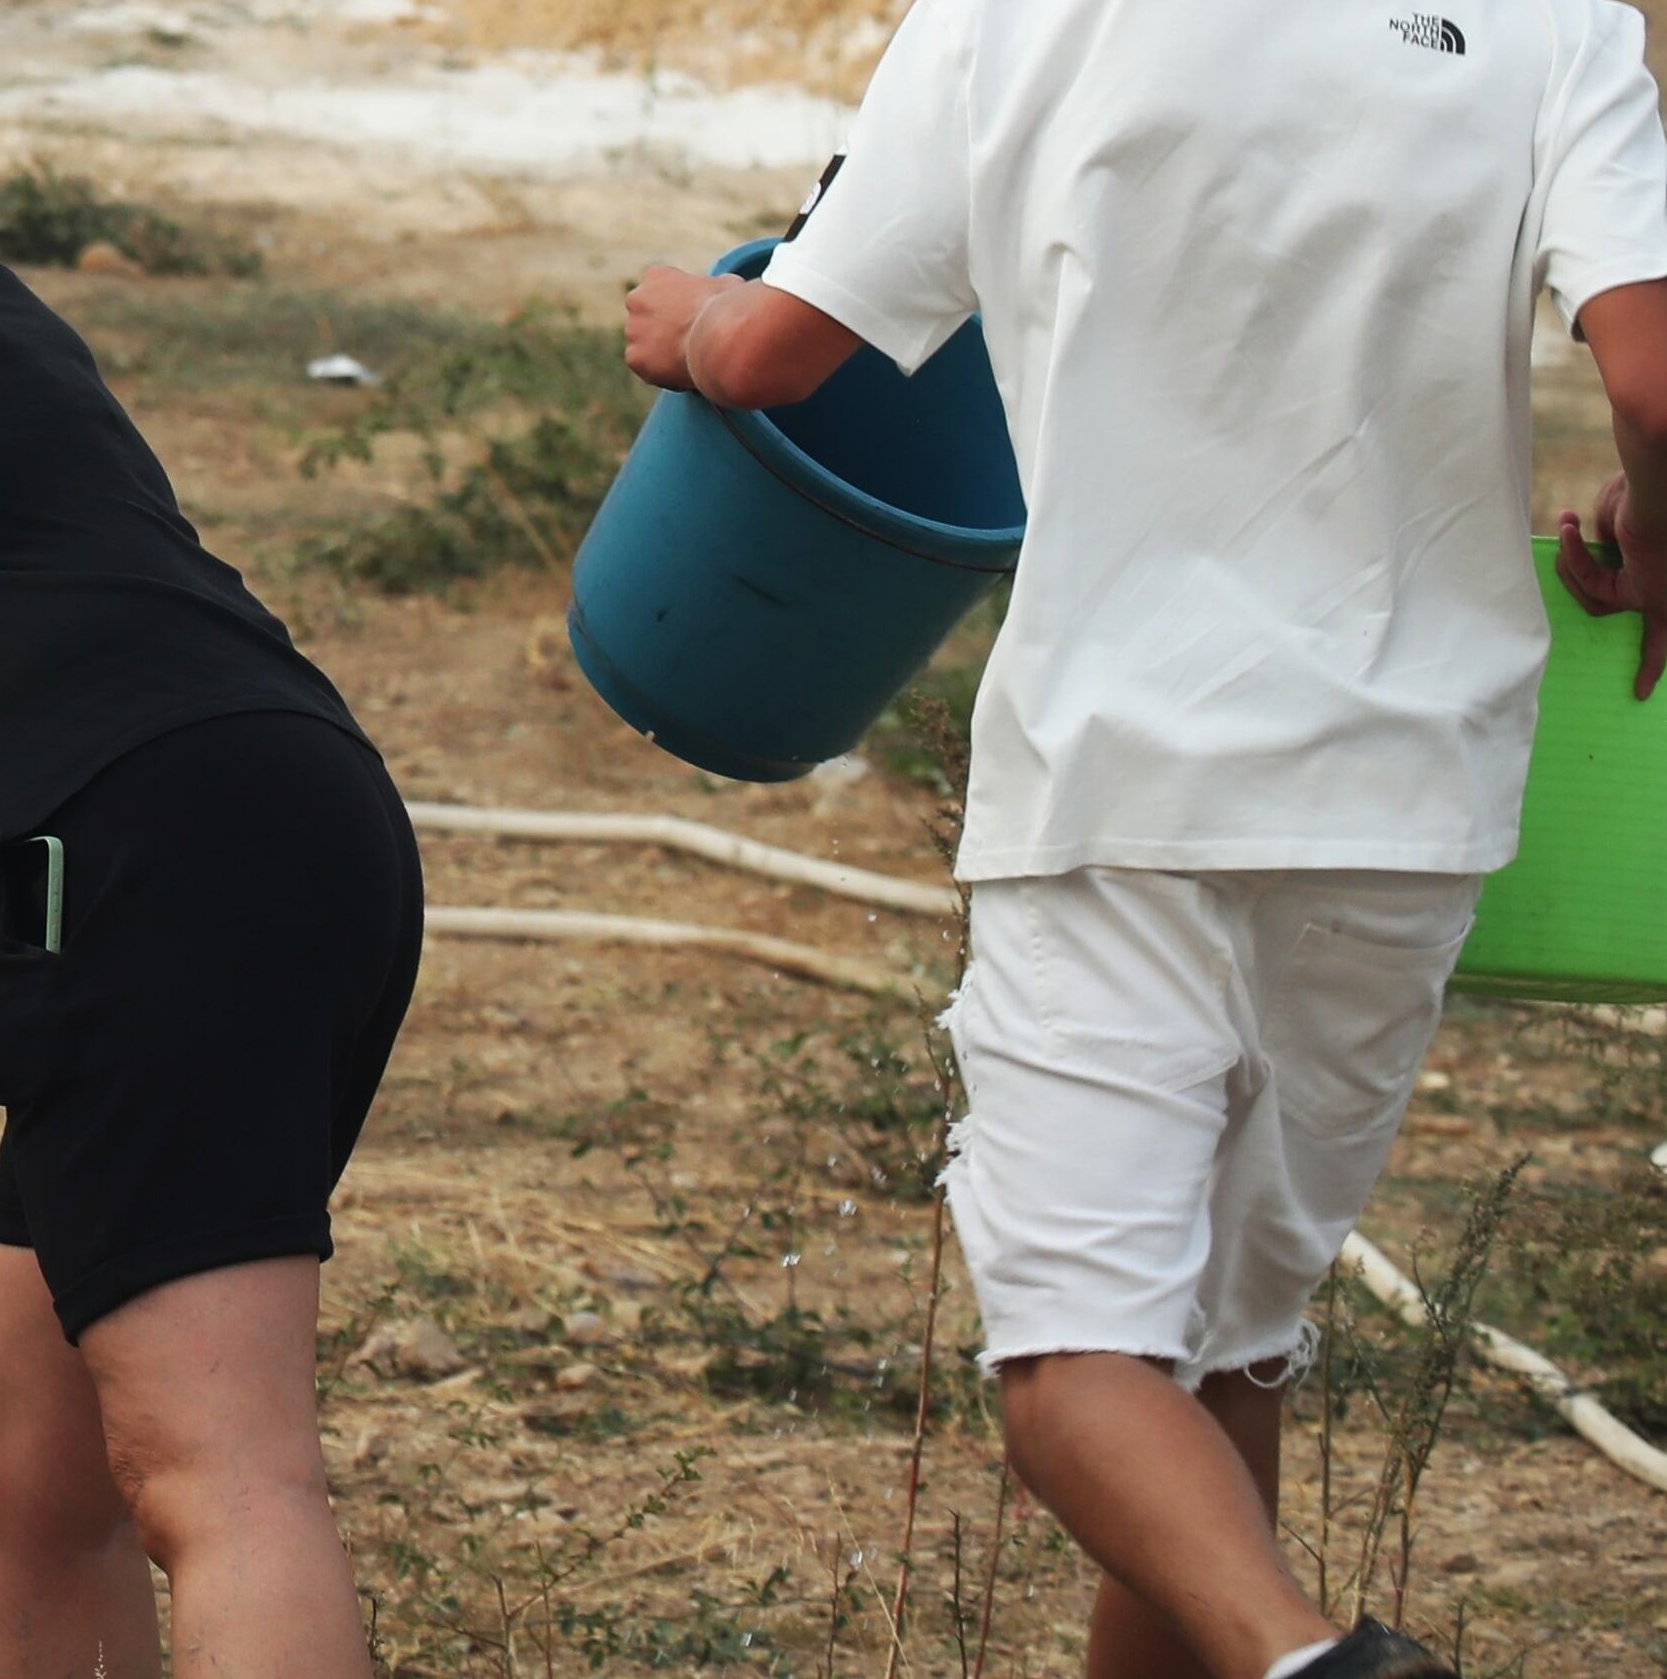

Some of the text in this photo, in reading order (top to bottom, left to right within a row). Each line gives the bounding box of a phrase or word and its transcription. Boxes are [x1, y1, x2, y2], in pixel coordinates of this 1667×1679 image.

[1389, 19, 1440, 39] NORTH
[1413, 12, 1439, 27] THE
[1403, 31, 1439, 50] FACE
